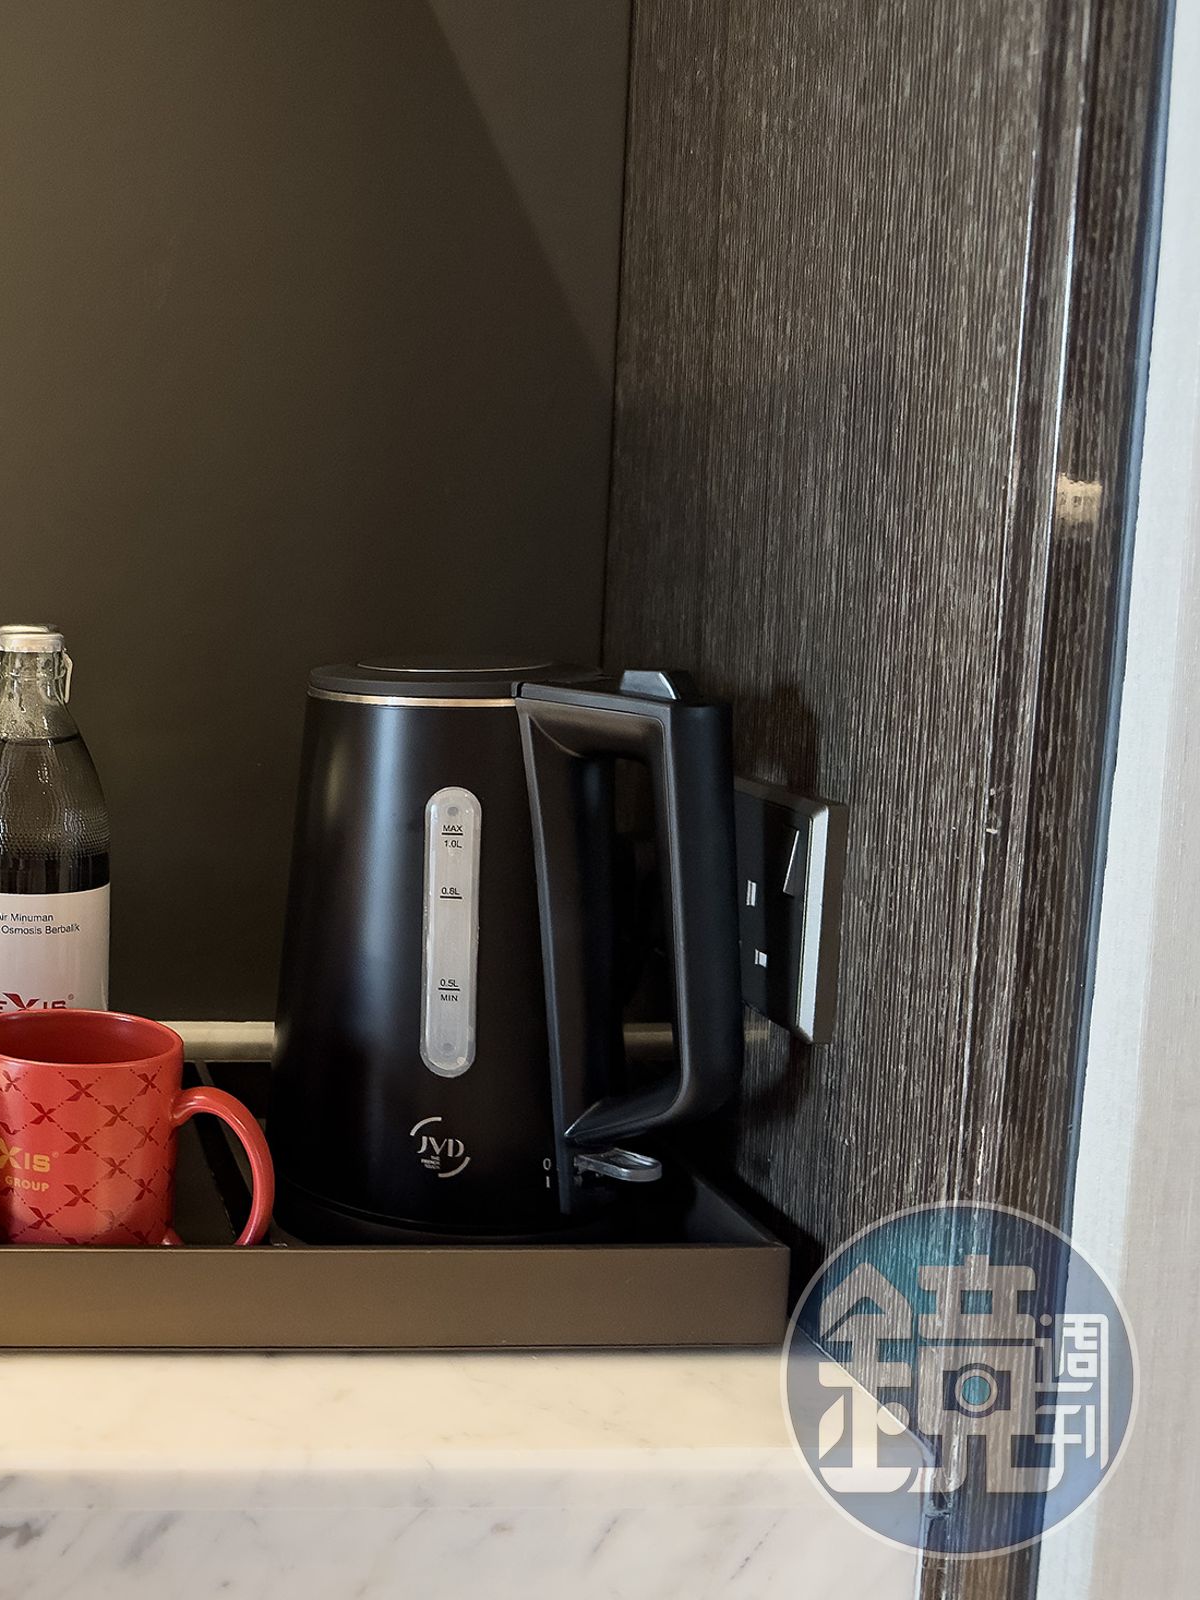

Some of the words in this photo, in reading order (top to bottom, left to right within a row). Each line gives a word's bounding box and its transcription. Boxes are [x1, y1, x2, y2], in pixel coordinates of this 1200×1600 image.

[442, 824, 463, 833] MAX
[444, 839, 462, 849] 1.0L
[441, 887, 460, 896] 0.8L
[11, 912, 54, 922] Minuman
[1, 924, 42, 935] Osmosis
[45, 922, 80, 934] Berbalik
[439, 978, 459, 988] 0.5L
[440, 994, 458, 1002] MIN
[416, 1135, 465, 1158] JVD
[5, 1175, 50, 1192] GROUP
